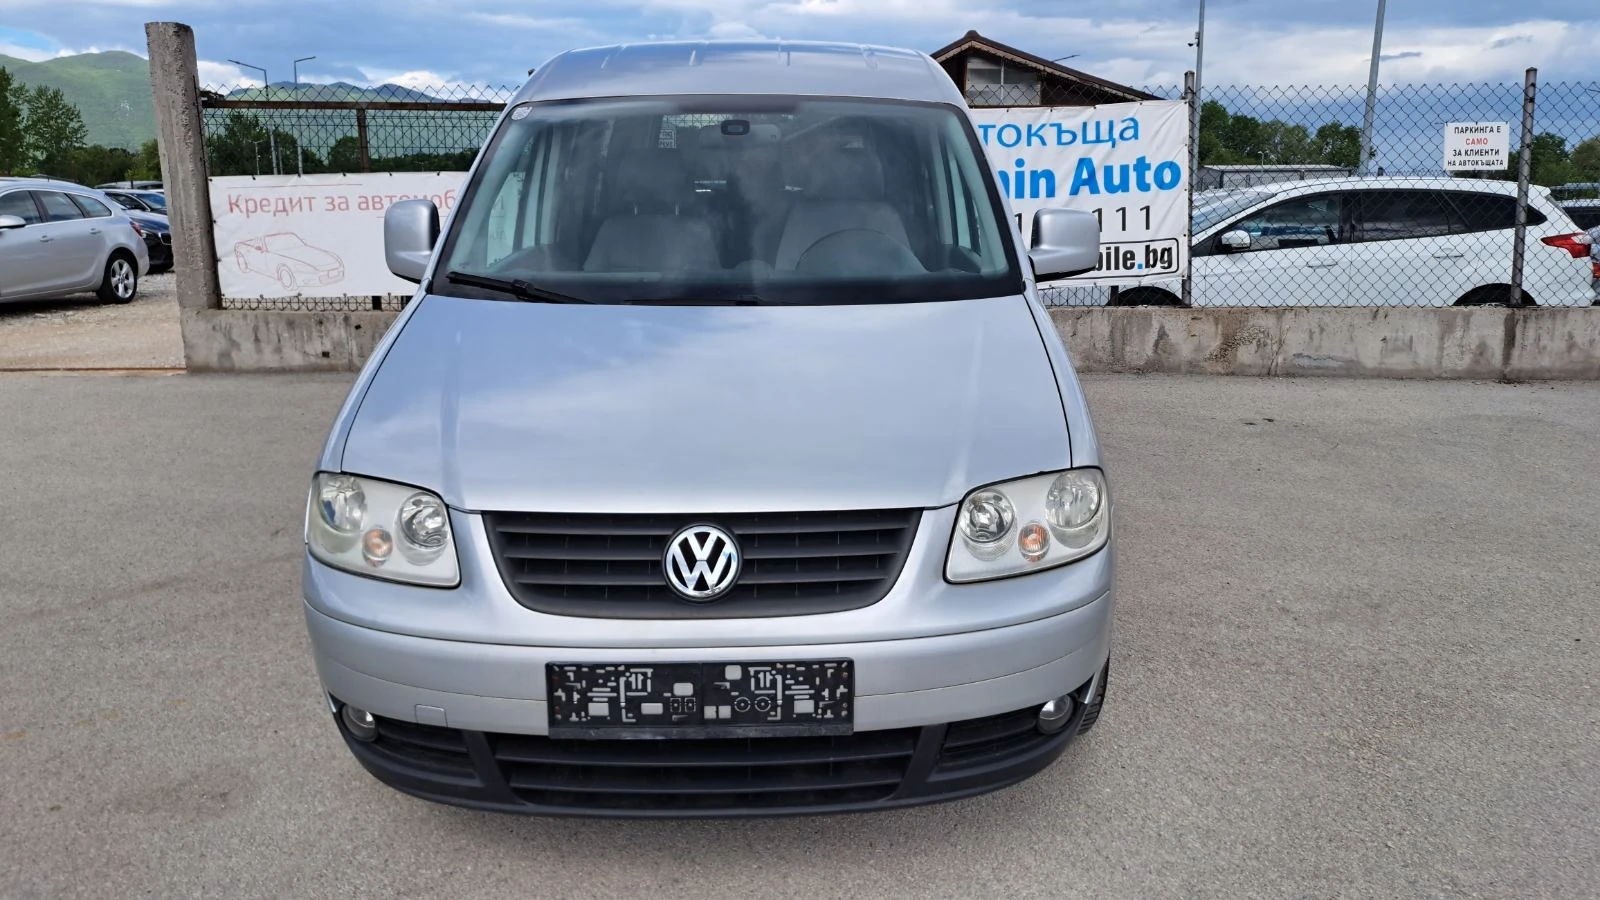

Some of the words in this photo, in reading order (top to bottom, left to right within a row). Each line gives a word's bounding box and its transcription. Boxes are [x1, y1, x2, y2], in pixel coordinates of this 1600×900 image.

[1454, 126, 1494, 134] ПАРКИНГА
[1452, 149, 1462, 157] ЗА
[1464, 149, 1500, 157] КЛИЕНТИ
[1069, 155, 1182, 197] Auto
[227, 193, 317, 219] Кредит
[324, 196, 350, 212] за
